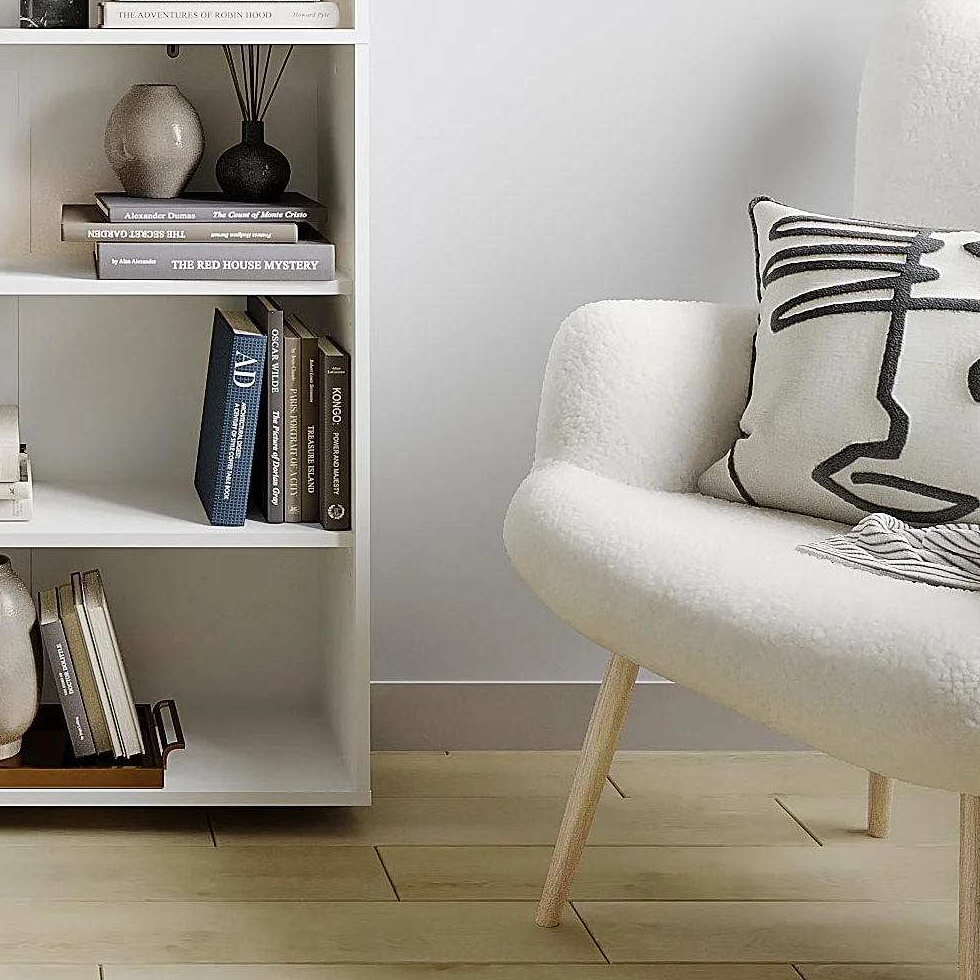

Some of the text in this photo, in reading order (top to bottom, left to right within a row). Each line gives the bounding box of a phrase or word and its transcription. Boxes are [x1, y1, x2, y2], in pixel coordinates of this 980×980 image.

[119, 11, 136, 19] THE
[137, 11, 198, 19] ADVENTURES
[200, 11, 214, 19] OF
[214, 11, 243, 19] ROBIN
[245, 11, 272, 19] HOOD
[123, 210, 308, 220] Alexander Dumas The Count of Monte Cristo
[87, 229, 128, 239] GARDEN
[128, 230, 165, 239] SECRET
[166, 230, 186, 238] THE
[171, 260, 195, 270] THE
[197, 260, 221, 270] RED
[222, 260, 262, 270] HOUSE
[263, 260, 320, 270] MYSTERY
[233, 350, 258, 388] AD
[289, 388, 298, 414] PARIS:
[332, 387, 342, 425] KONGO:
[271, 328, 281, 506] OSCAR WILDE The Picture of Dorian Gray
[289, 415, 298, 457] PORTRAIT
[307, 424, 315, 464] TREASURE
[289, 458, 297, 469] OF
[289, 477, 297, 497] CITY
[307, 464, 315, 494] ISLAND
[56, 643, 68, 671] DOLITTLE
[64, 670, 75, 695] DOCTOR
